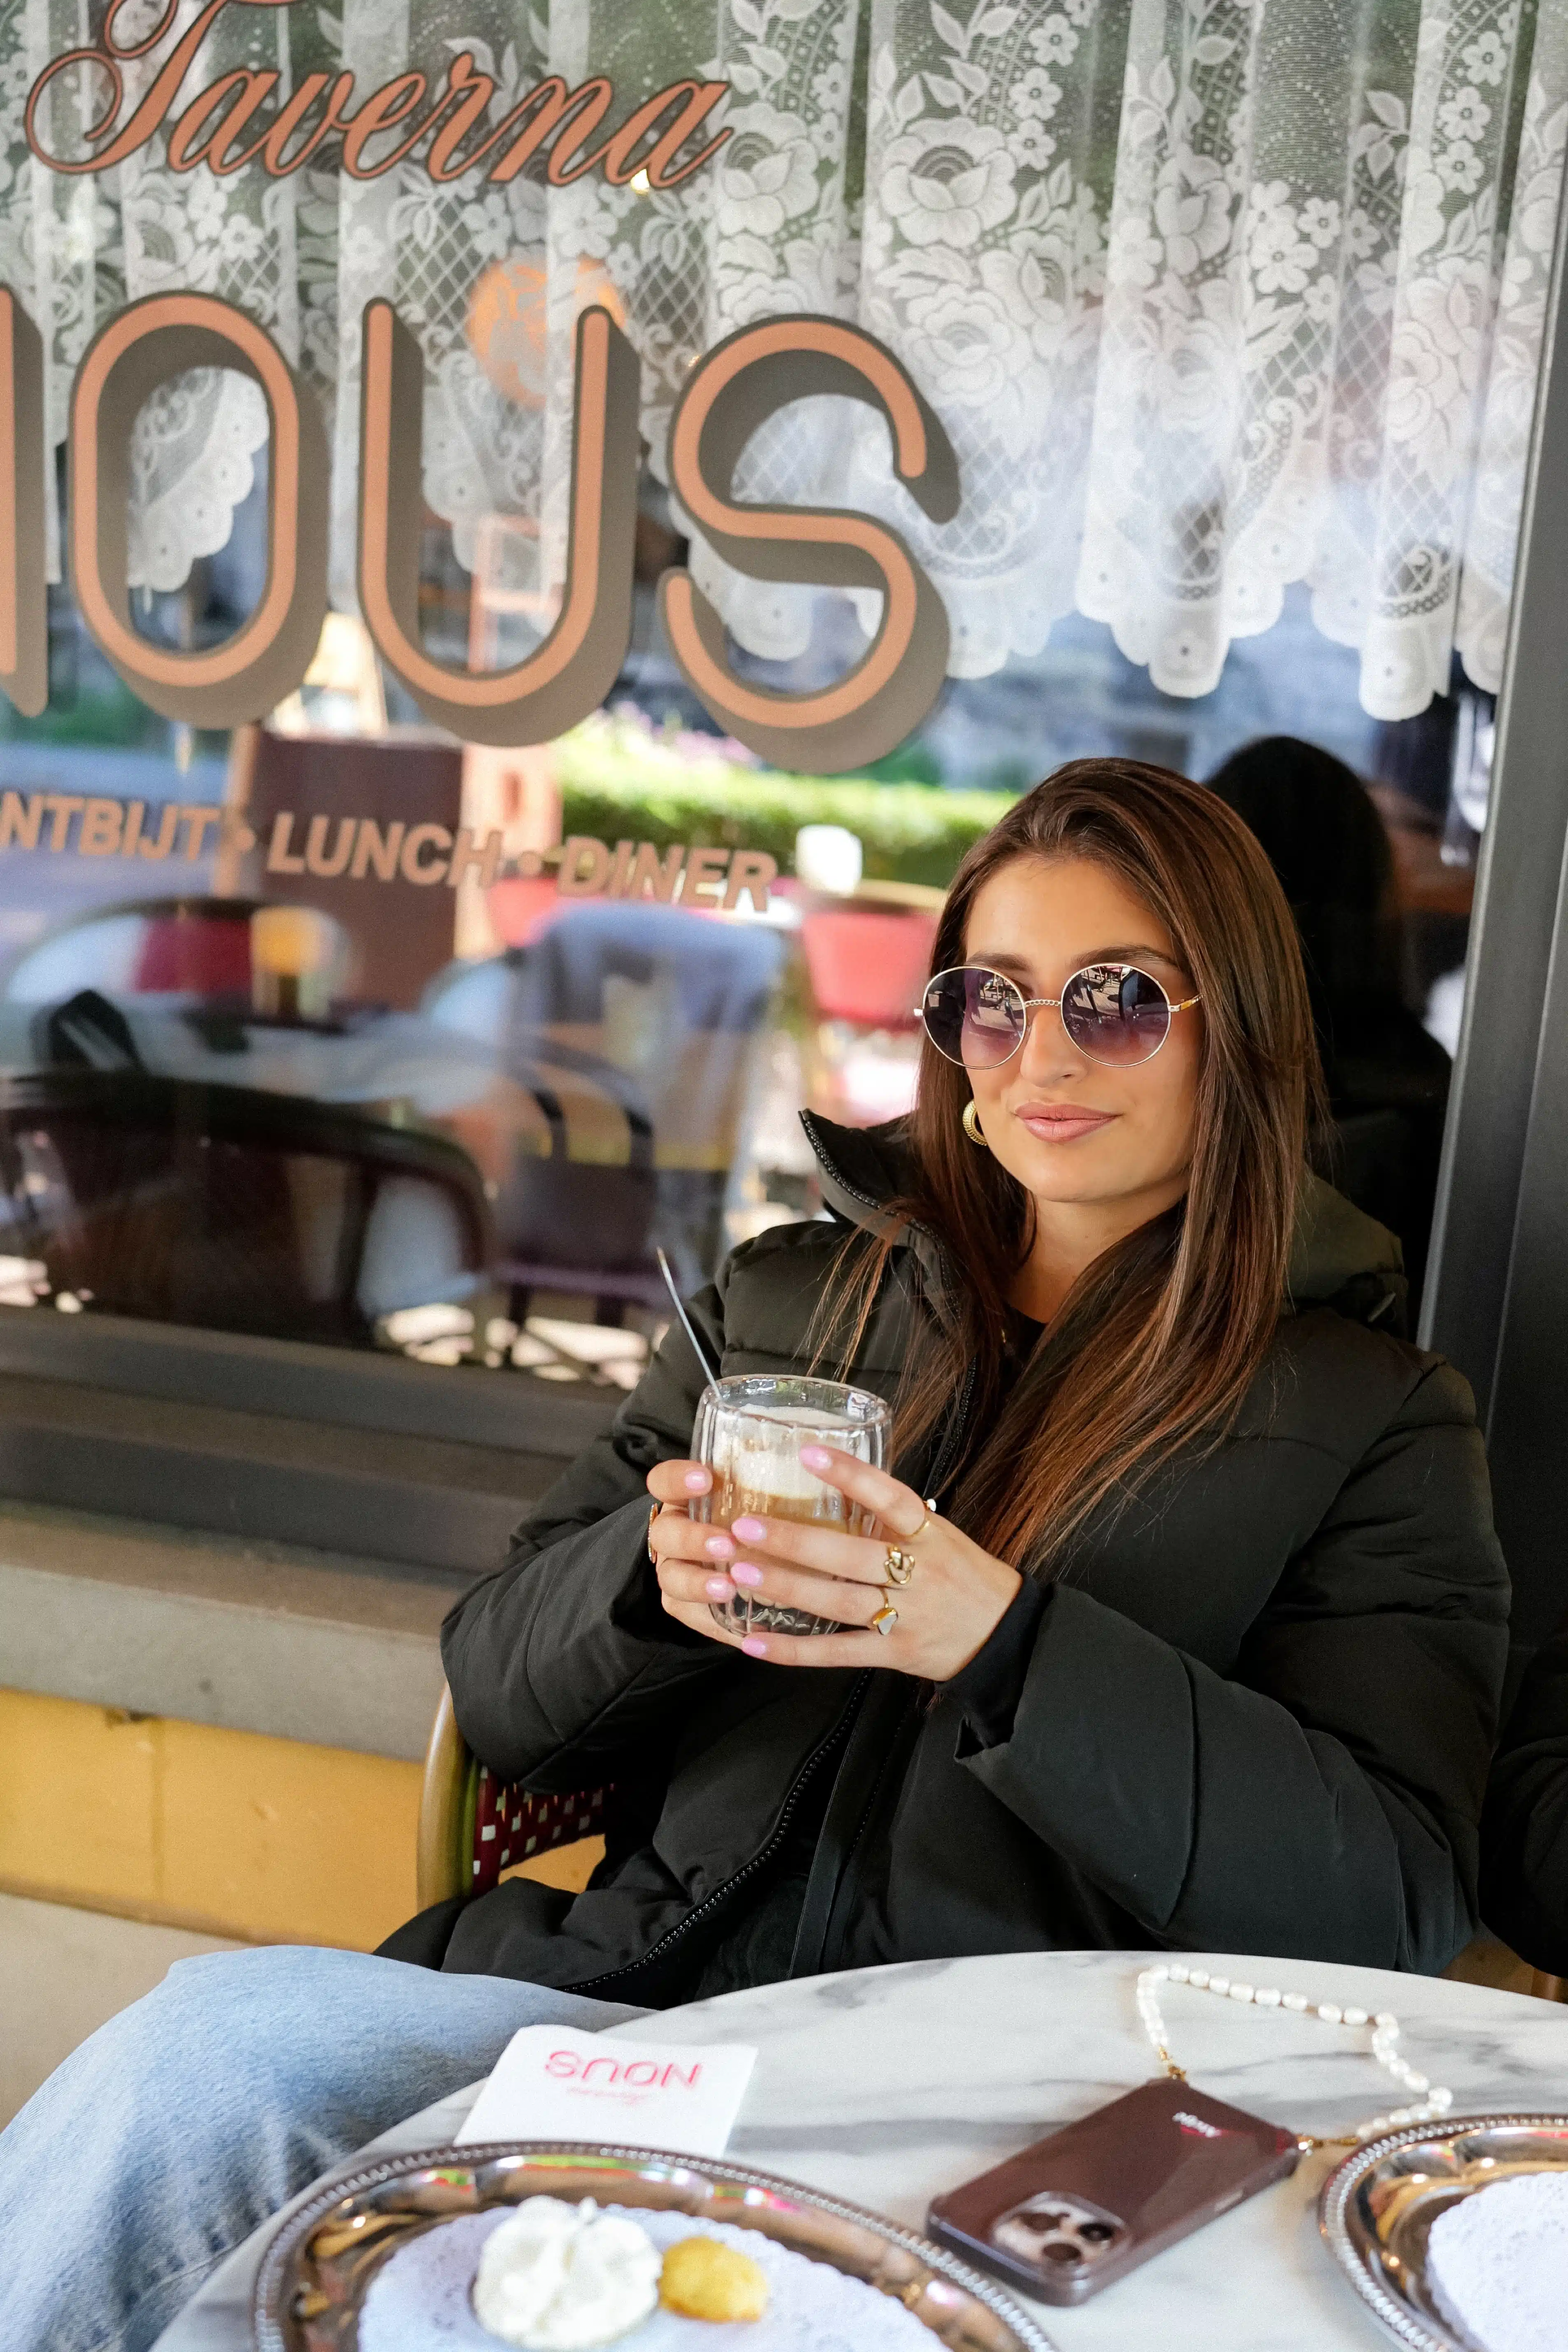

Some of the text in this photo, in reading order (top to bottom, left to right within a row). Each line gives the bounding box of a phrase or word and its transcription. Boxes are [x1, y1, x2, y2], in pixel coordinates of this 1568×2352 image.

[25, 0, 734, 189] Taverna
[0, 284, 961, 775] OUS
[267, 811, 503, 889] LUNCH
[557, 835, 778, 912] DINER
[545, 2050, 703, 2088] NOUS
